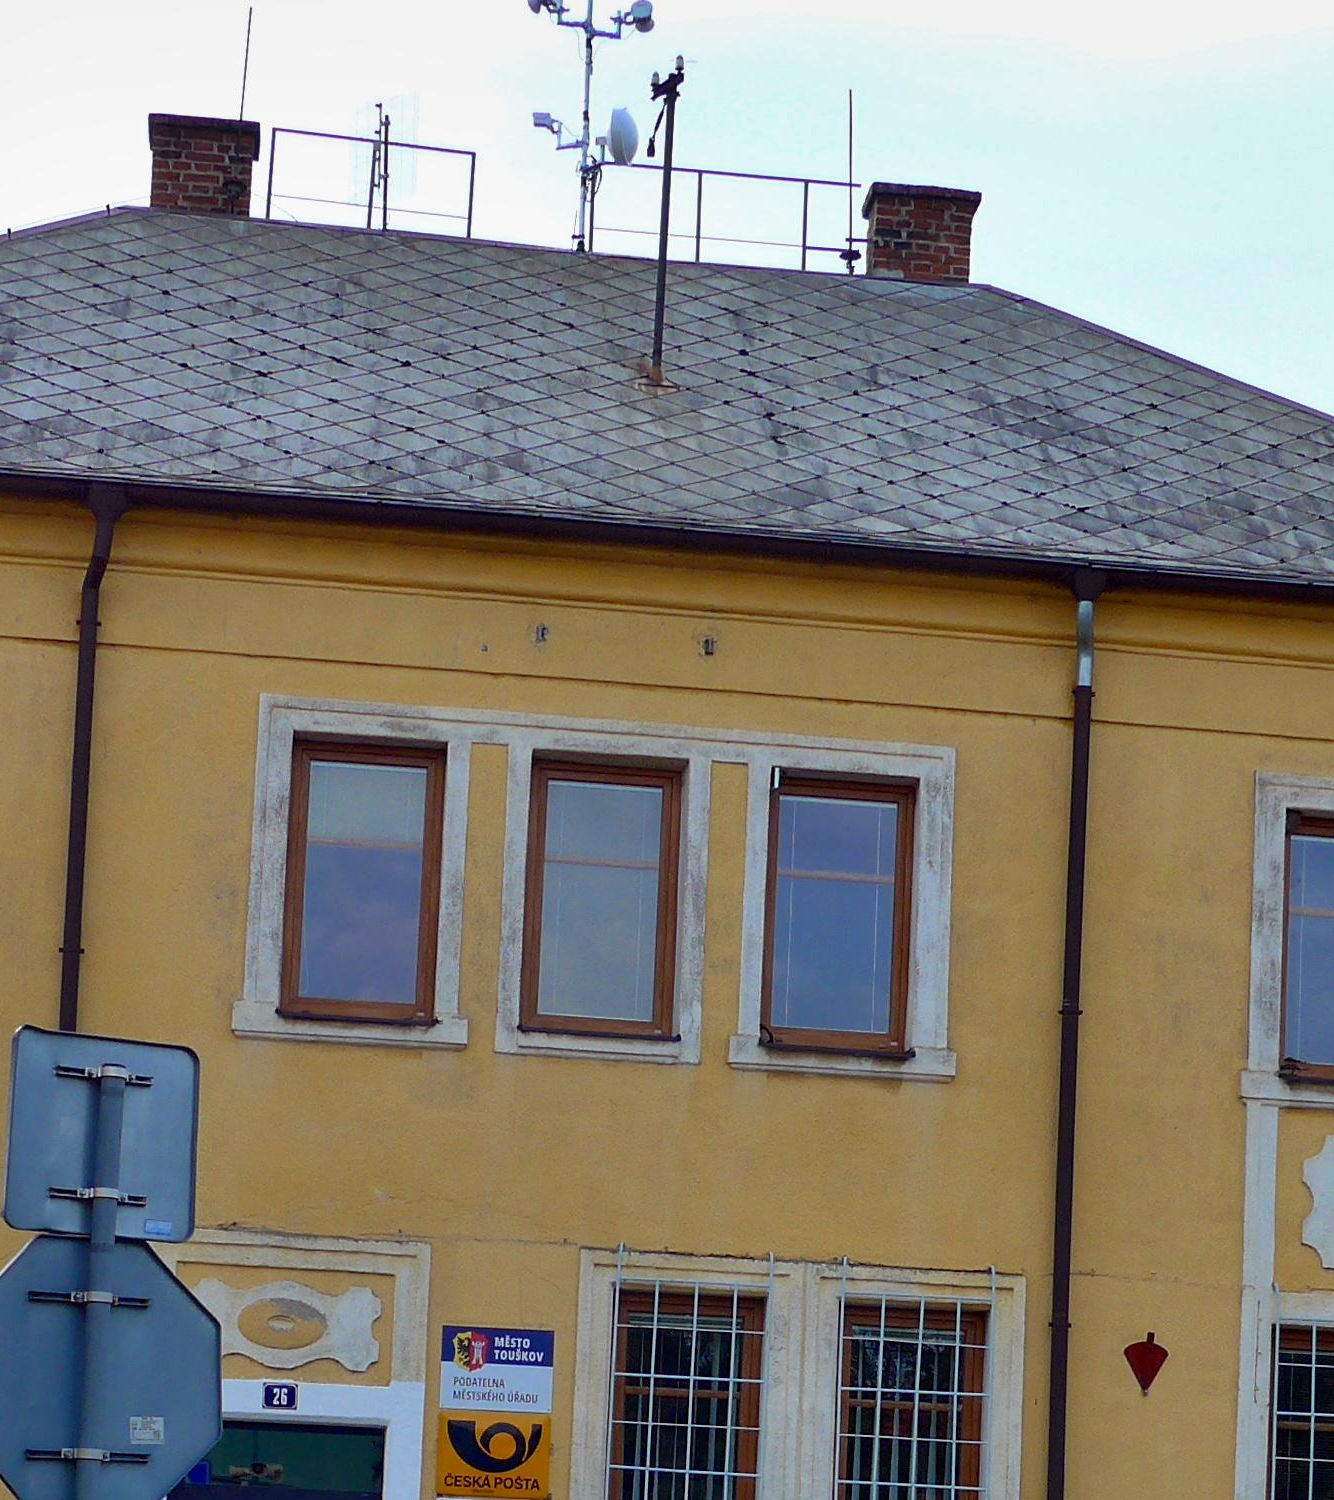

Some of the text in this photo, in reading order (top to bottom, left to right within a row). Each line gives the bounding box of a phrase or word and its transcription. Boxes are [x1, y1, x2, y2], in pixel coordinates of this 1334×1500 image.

[494, 1335, 530, 1349] MĚSTO
[493, 1348, 544, 1362] TOUŠKOV
[453, 1377, 505, 1388] PODATELNA
[273, 1388, 288, 1405] 26
[452, 1389, 538, 1404] MĚSTSKÉHO ÚŘADU
[444, 1473, 540, 1491] ČESKÁ POŠTA
